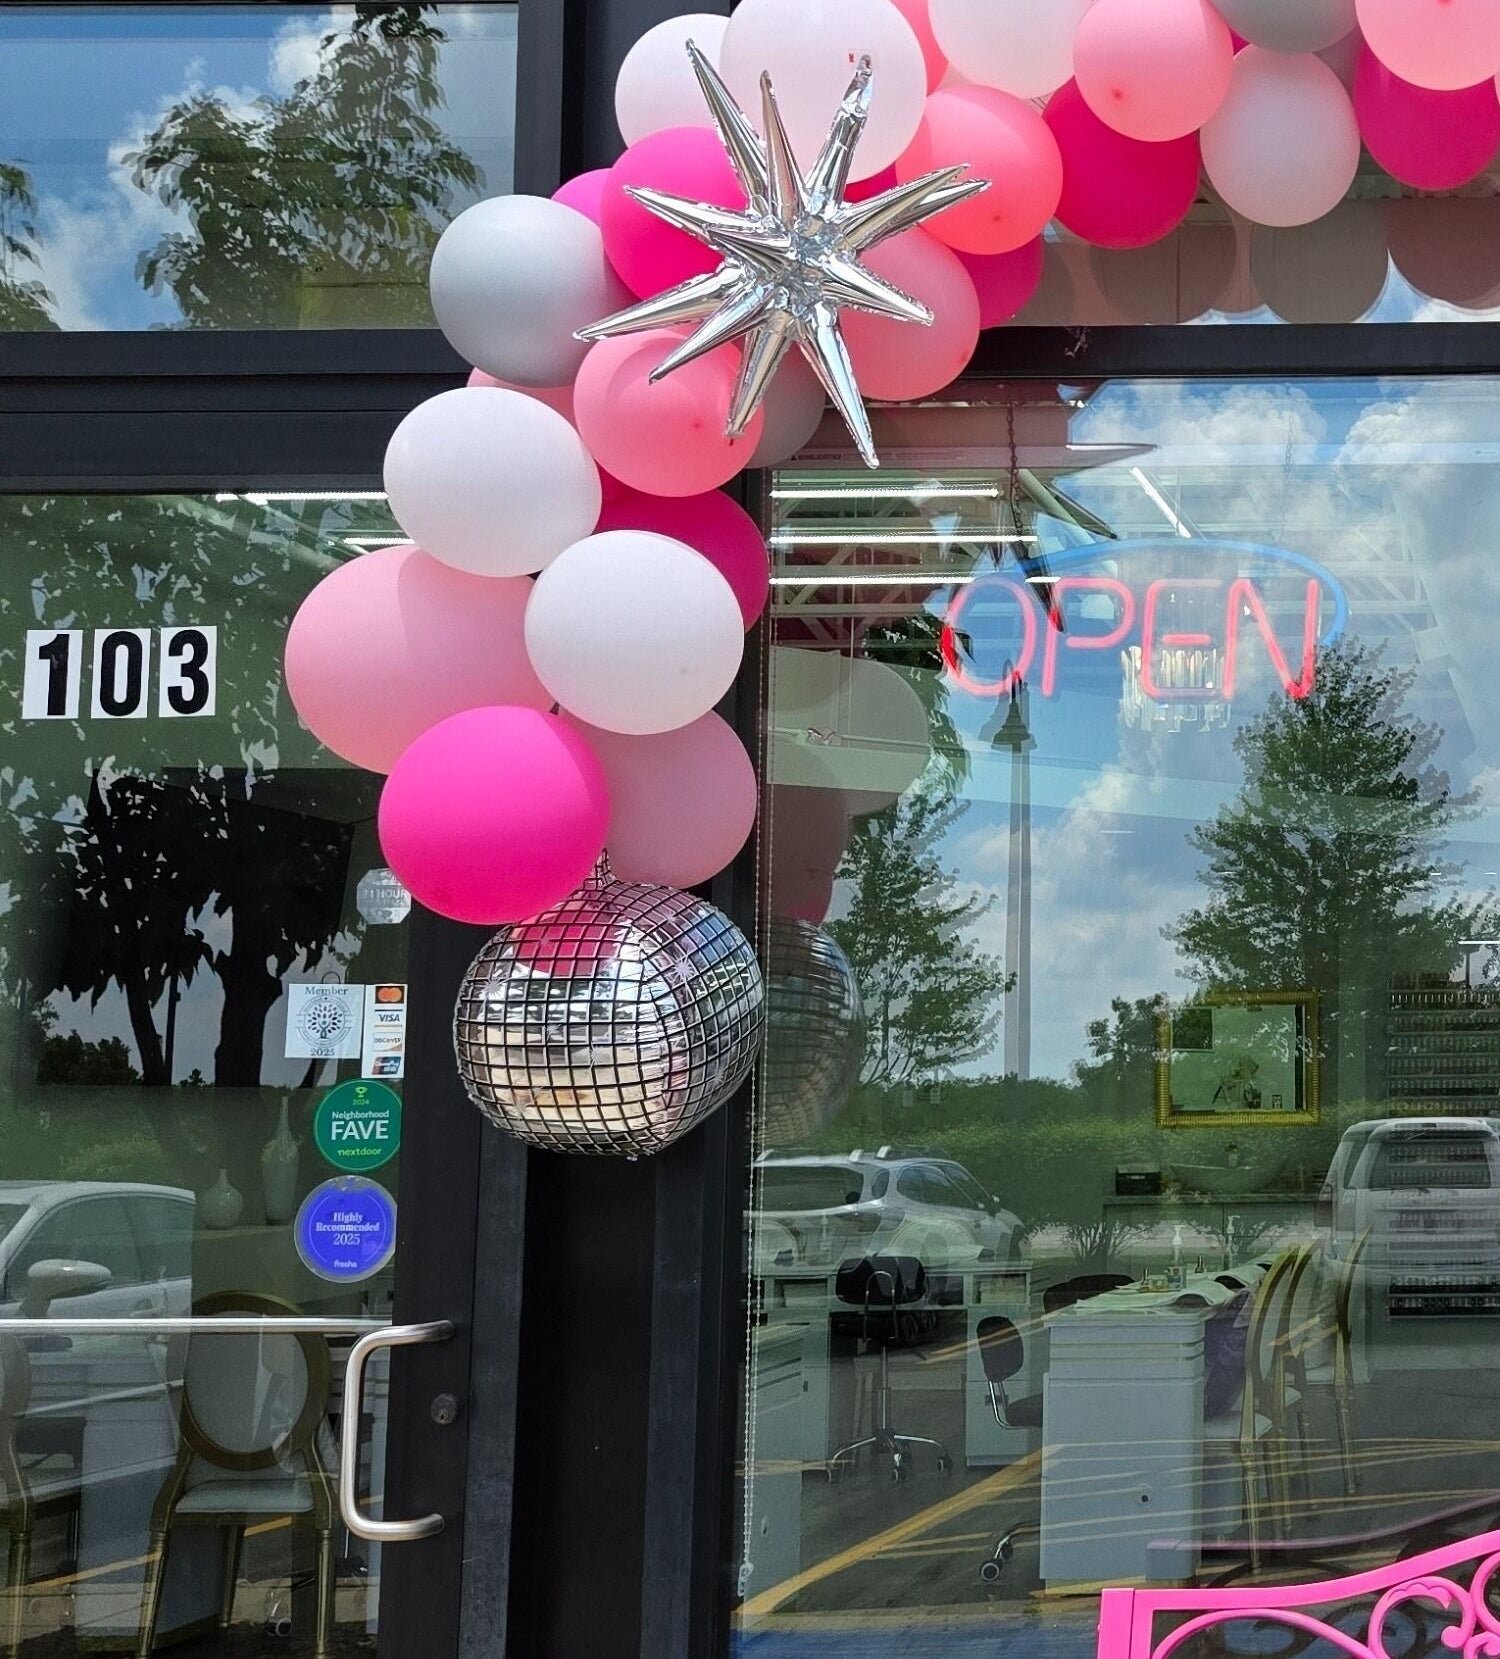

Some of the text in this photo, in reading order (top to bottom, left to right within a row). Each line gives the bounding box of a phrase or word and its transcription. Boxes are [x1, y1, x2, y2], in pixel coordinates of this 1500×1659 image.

[940, 576, 1319, 700] OPEN
[37, 628, 210, 717] 103
[305, 986, 349, 996] Member
[379, 1014, 401, 1022] VISA
[310, 1047, 335, 1057] 2025
[331, 1109, 390, 1121] Neighborhood
[331, 1120, 389, 1140] FAVE
[337, 1147, 382, 1157] nextdoor
[333, 1212, 363, 1223] Highly
[315, 1222, 380, 1232] Recommended
[333, 1233, 361, 1246] 2025
